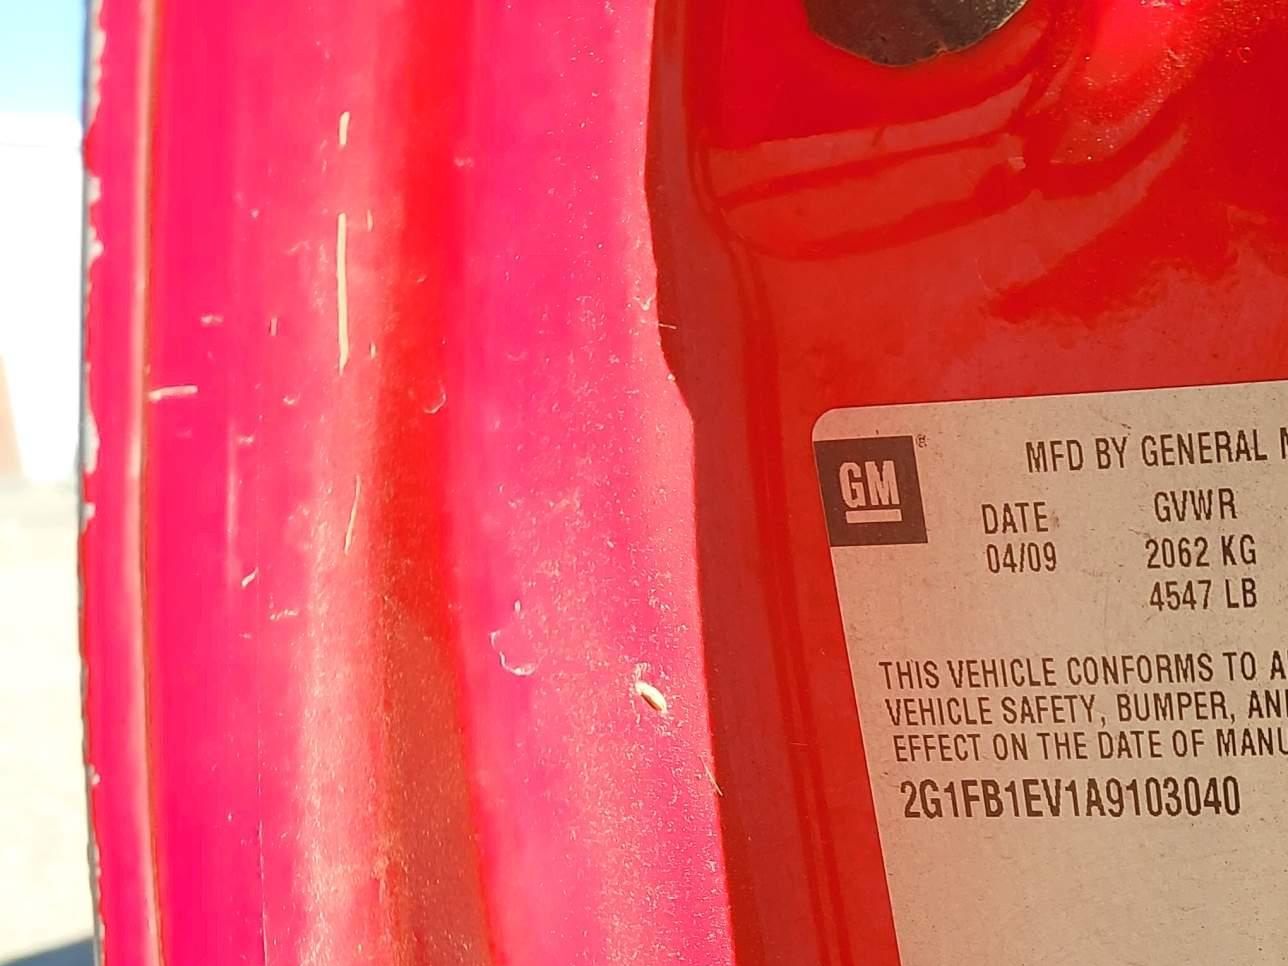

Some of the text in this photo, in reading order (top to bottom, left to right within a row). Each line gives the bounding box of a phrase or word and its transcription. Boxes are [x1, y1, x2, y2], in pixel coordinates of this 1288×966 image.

[1026, 440, 1083, 473] MFD
[1095, 437, 1127, 469] BY
[1141, 429, 1267, 466] GENERAL
[839, 461, 900, 508] GM
[982, 502, 1048, 534] DATE
[1154, 488, 1237, 522] GVWR
[987, 542, 1056, 573] 04/09
[1145, 534, 1256, 568] 2062 KG
[1150, 578, 1257, 611] 4547 LB
[879, 661, 939, 689] THIS
[947, 658, 1056, 688] VEHICLE
[1067, 653, 1213, 685] CONFORMS
[1222, 652, 1256, 681] TO
[885, 697, 992, 726] VEHICLE
[1001, 695, 1105, 727] SAFETY,
[1117, 691, 1235, 724] BUMPER,
[893, 734, 980, 761] EFFECT
[993, 733, 1028, 760] ON
[1037, 732, 1088, 760] THE
[1098, 731, 1162, 759] DATE
[1172, 729, 1204, 757] OF
[901, 776, 1240, 819] 2G1FB1EV1A9103040
